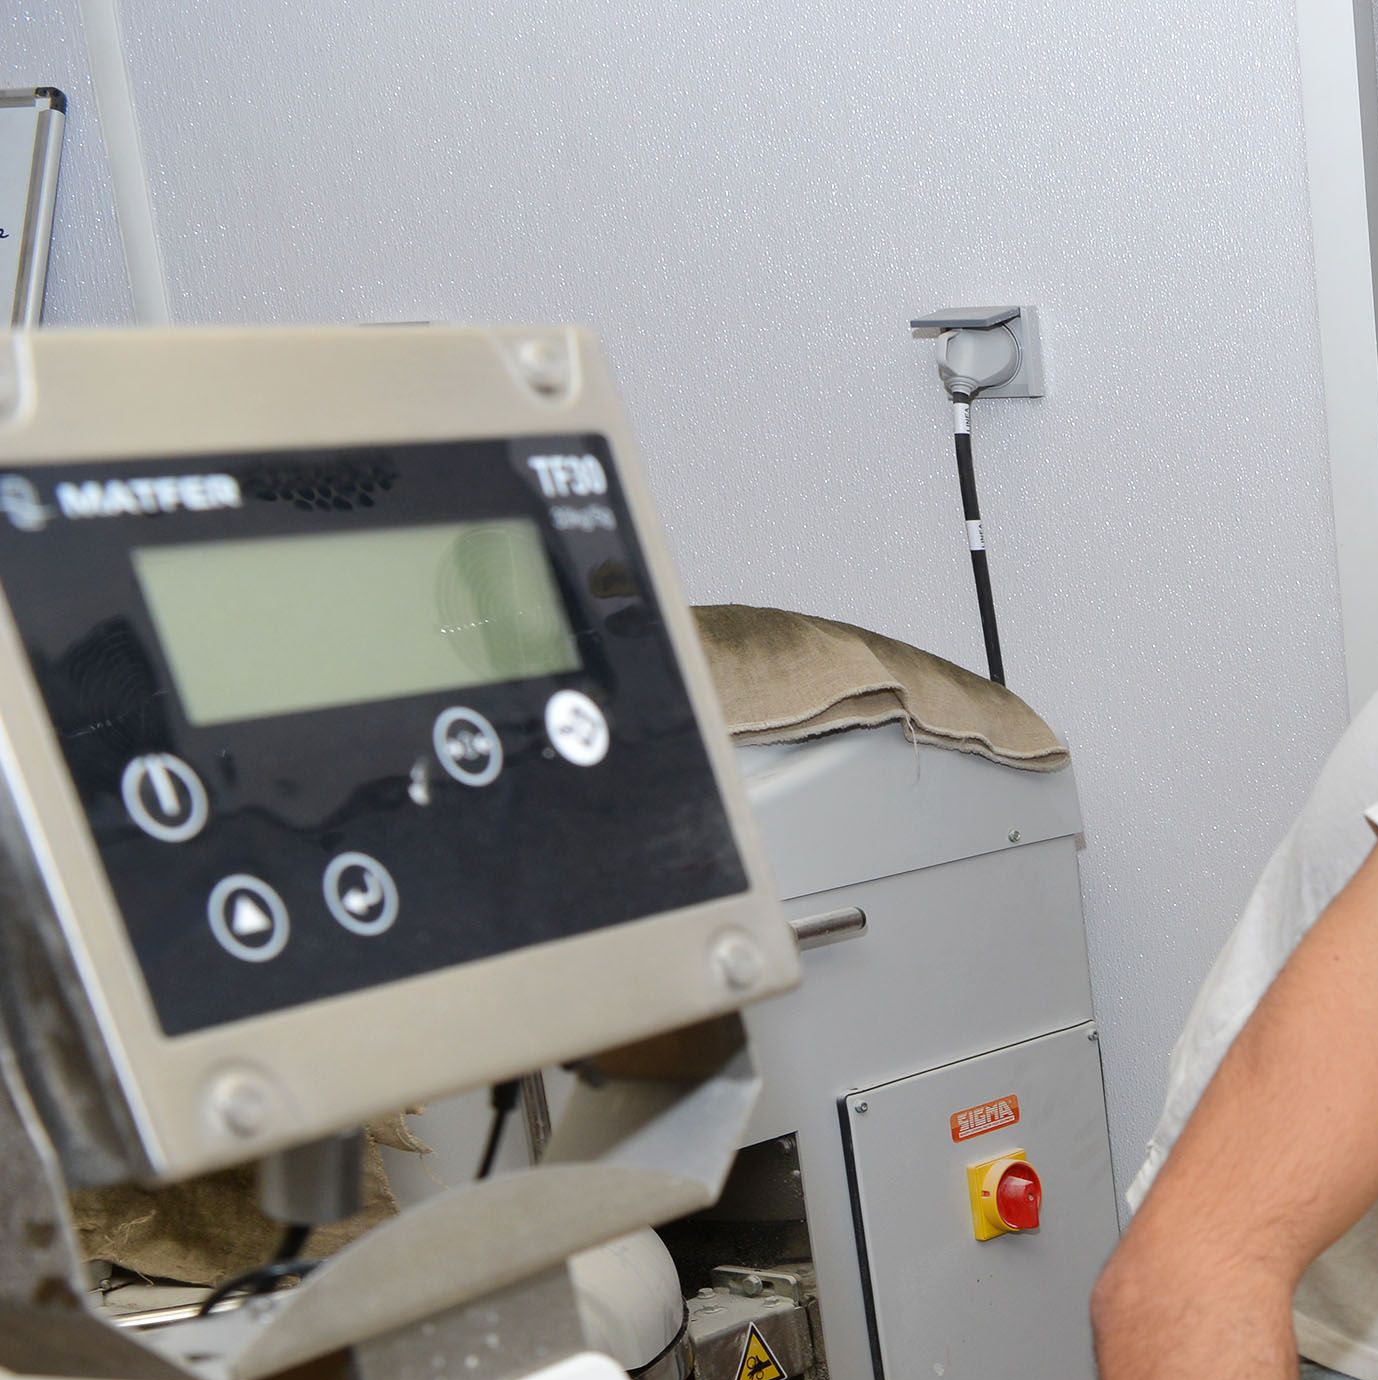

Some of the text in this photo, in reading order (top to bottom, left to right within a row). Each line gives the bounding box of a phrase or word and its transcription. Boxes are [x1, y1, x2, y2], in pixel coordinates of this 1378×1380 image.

[56, 473, 243, 519] MATFER
[528, 453, 608, 498] TF30
[957, 1101, 1014, 1132] SIGMA
